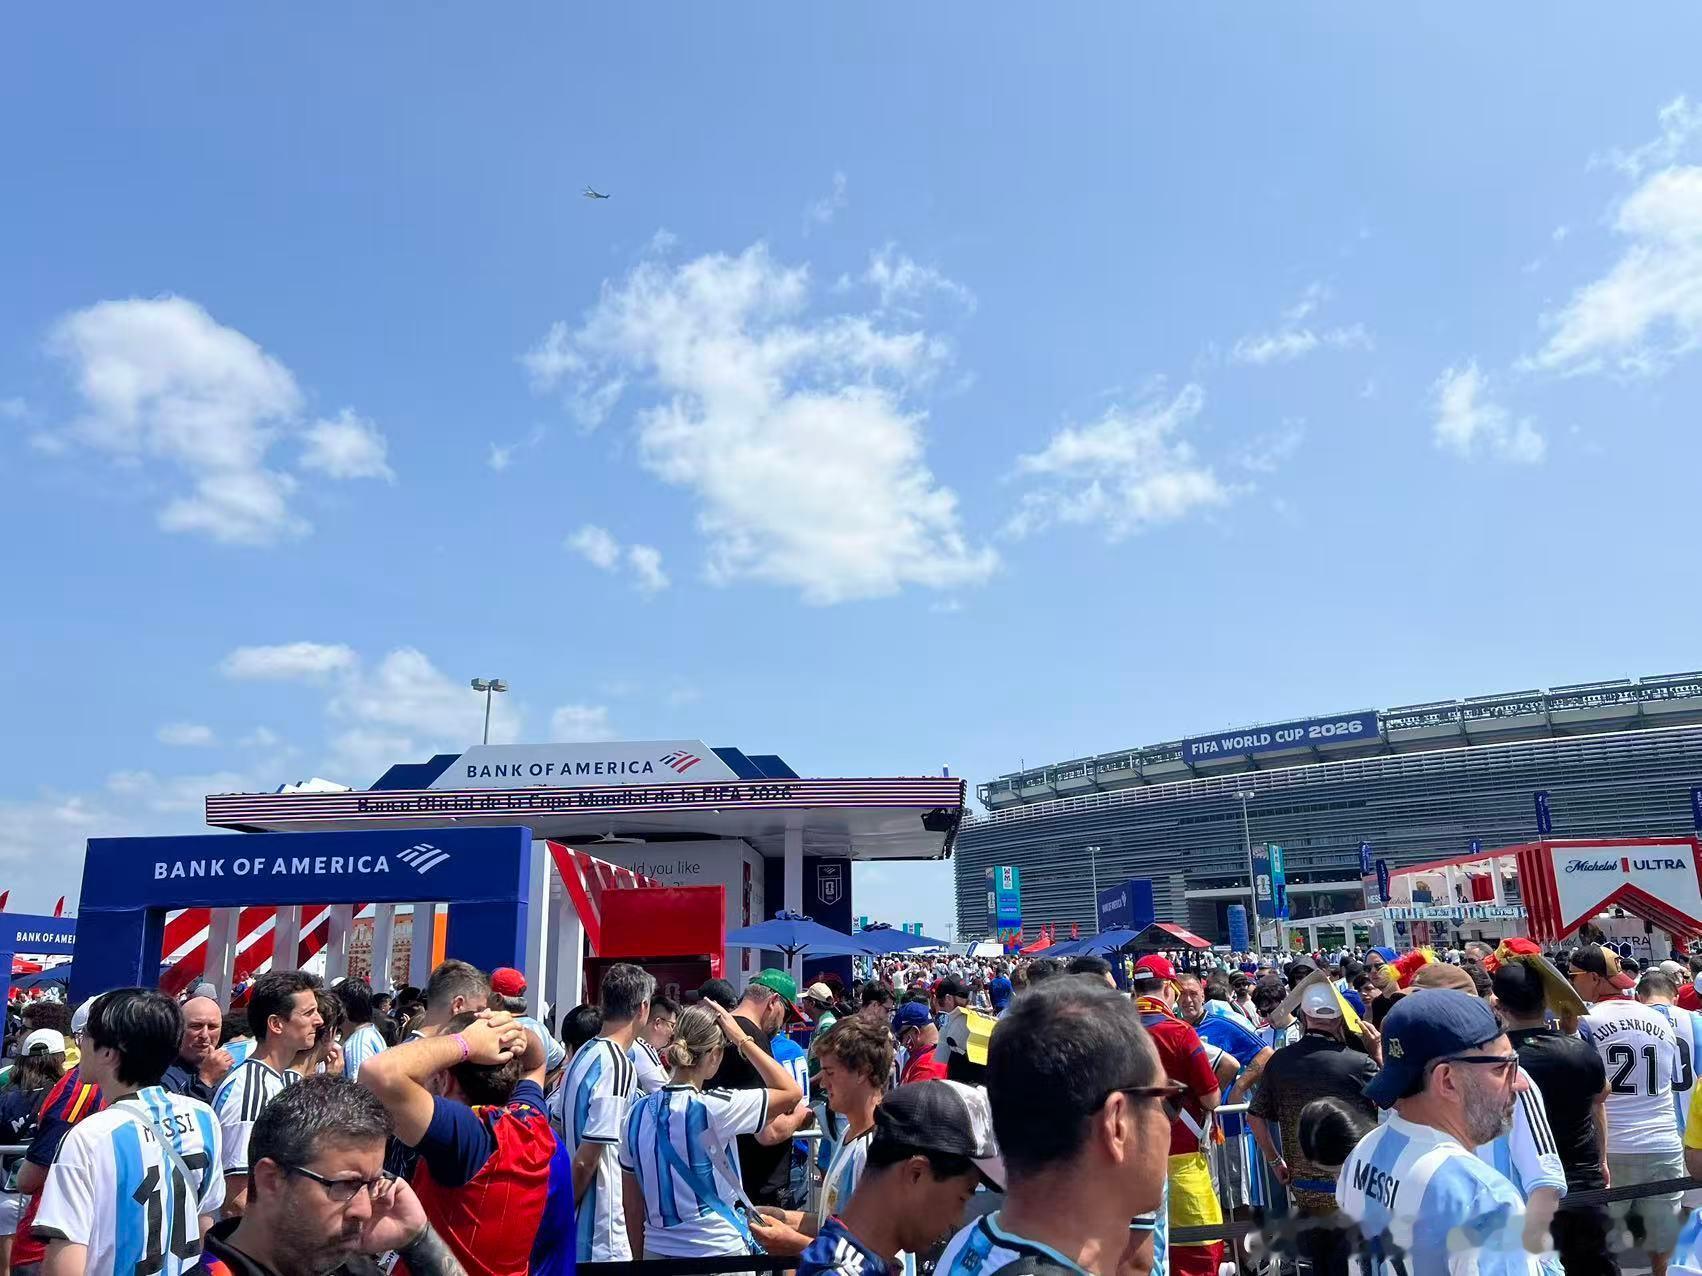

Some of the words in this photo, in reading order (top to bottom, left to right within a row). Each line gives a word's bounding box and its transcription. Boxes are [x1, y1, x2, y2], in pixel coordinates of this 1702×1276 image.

[1191, 741, 1219, 755] FIFA
[1222, 732, 1270, 750] WORLD
[1275, 728, 1304, 743] CUP
[1309, 720, 1363, 738] 2026
[467, 763, 522, 778] BANK
[530, 762, 555, 776] OF
[560, 760, 654, 776] AMERICA
[358, 797, 410, 812] Banco
[579, 789, 648, 807] Mundial
[703, 786, 740, 802] FIFA
[154, 859, 226, 879] BANK
[232, 857, 266, 876] OF
[272, 855, 390, 875] AMERICA
[650, 863, 673, 878] you
[678, 860, 700, 874] like
[1565, 859, 1617, 873] Michelob
[1633, 858, 1686, 870] ULTRA
[16, 931, 41, 942] BANK
[42, 933, 54, 942] OF
[1593, 1021, 1618, 1042] LUIS
[1619, 1018, 1666, 1041] ENRIQUE
[1606, 1043, 1659, 1096] 21
[143, 1113, 195, 1143] MSSI
[1353, 1159, 1400, 1209] MESSI
